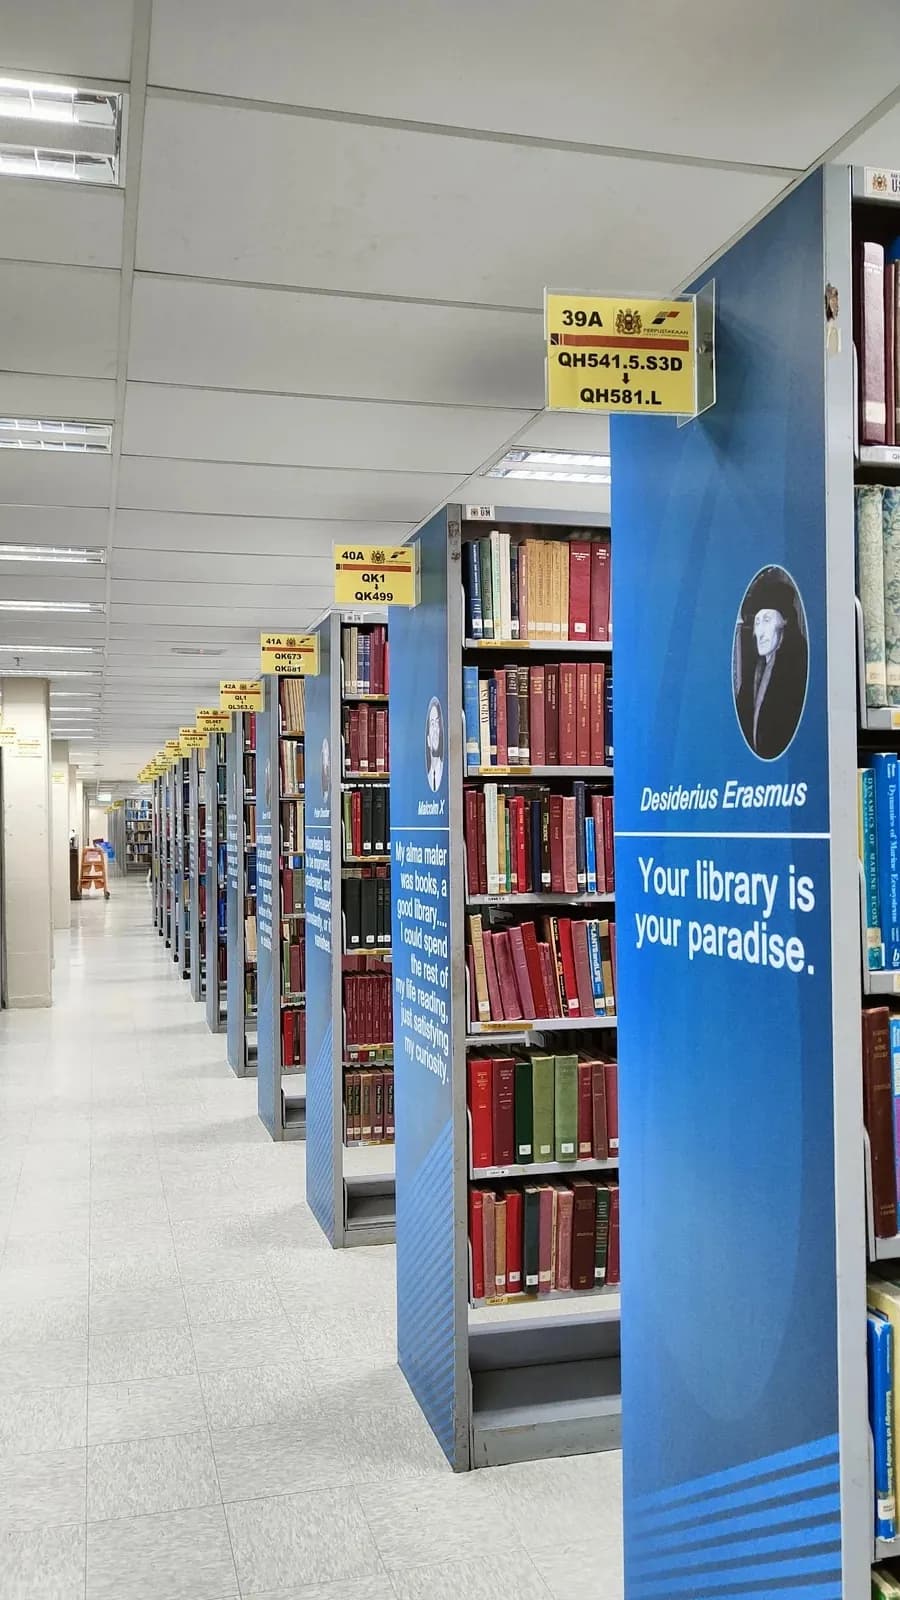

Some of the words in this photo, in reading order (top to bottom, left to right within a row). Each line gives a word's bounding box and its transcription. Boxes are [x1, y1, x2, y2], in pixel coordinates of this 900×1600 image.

[562, 310, 603, 327] 39A
[558, 352, 683, 371] QH541.5.S3D
[580, 388, 662, 405] QH581.L
[341, 551, 365, 561] 40A
[361, 573, 385, 583] QK1
[354, 592, 394, 601] QK499
[417, 799, 439, 815] Malcolm
[439, 799, 446, 815] X
[640, 783, 719, 812] Desiderius
[722, 780, 808, 809] Erasmus
[867, 777, 875, 828] DYNAMICS
[395, 841, 405, 866] My
[406, 842, 422, 864] alma
[424, 844, 447, 866] mater
[869, 833, 876, 845] OF
[869, 852, 877, 889] MARINE
[889, 841, 898, 871] Marine
[400, 872, 414, 890] was
[415, 870, 440, 899] books,
[441, 879, 447, 898] a
[638, 856, 690, 898] Your
[696, 859, 779, 919] library
[789, 864, 815, 912] is
[397, 897, 413, 920] good
[400, 920, 404, 941] I
[404, 926, 423, 949] could
[423, 934, 448, 959] spend
[635, 912, 682, 949] your
[688, 920, 815, 976] paradise.
[410, 953, 422, 977] the
[423, 962, 439, 985] rest
[440, 966, 449, 989] of
[395, 977, 406, 1000] my
[405, 978, 416, 1002] life
[417, 990, 449, 1025] reading,
[400, 1002, 413, 1029] just
[413, 1013, 449, 1057] satisfying
[404, 1035, 415, 1062] my
[415, 1045, 449, 1086] curiosity.
